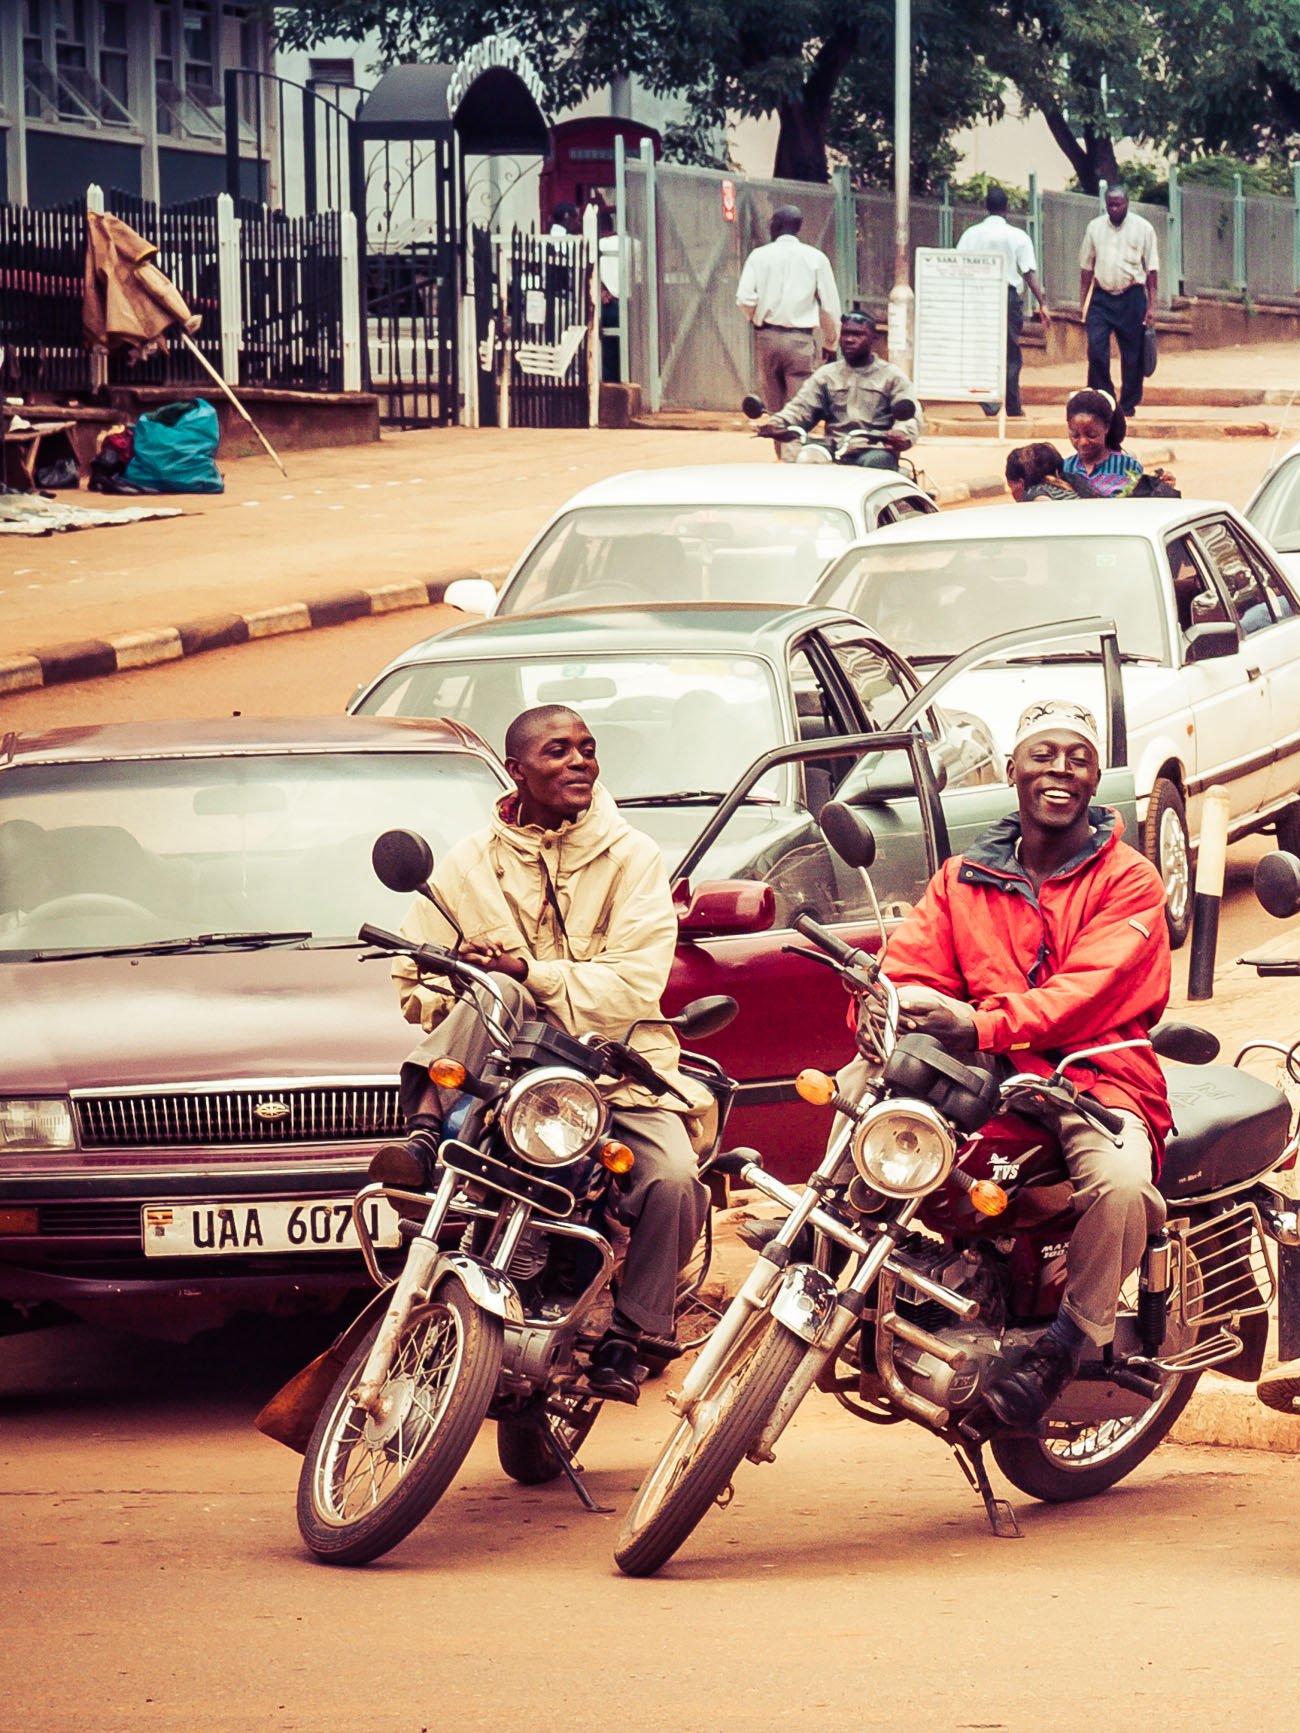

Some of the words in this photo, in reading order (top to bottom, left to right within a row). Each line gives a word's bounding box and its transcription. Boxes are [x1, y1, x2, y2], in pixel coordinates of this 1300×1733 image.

[991, 1164, 1020, 1181] TVS
[192, 1208, 264, 1250] UAA
[1041, 1242, 1071, 1253] MAX
